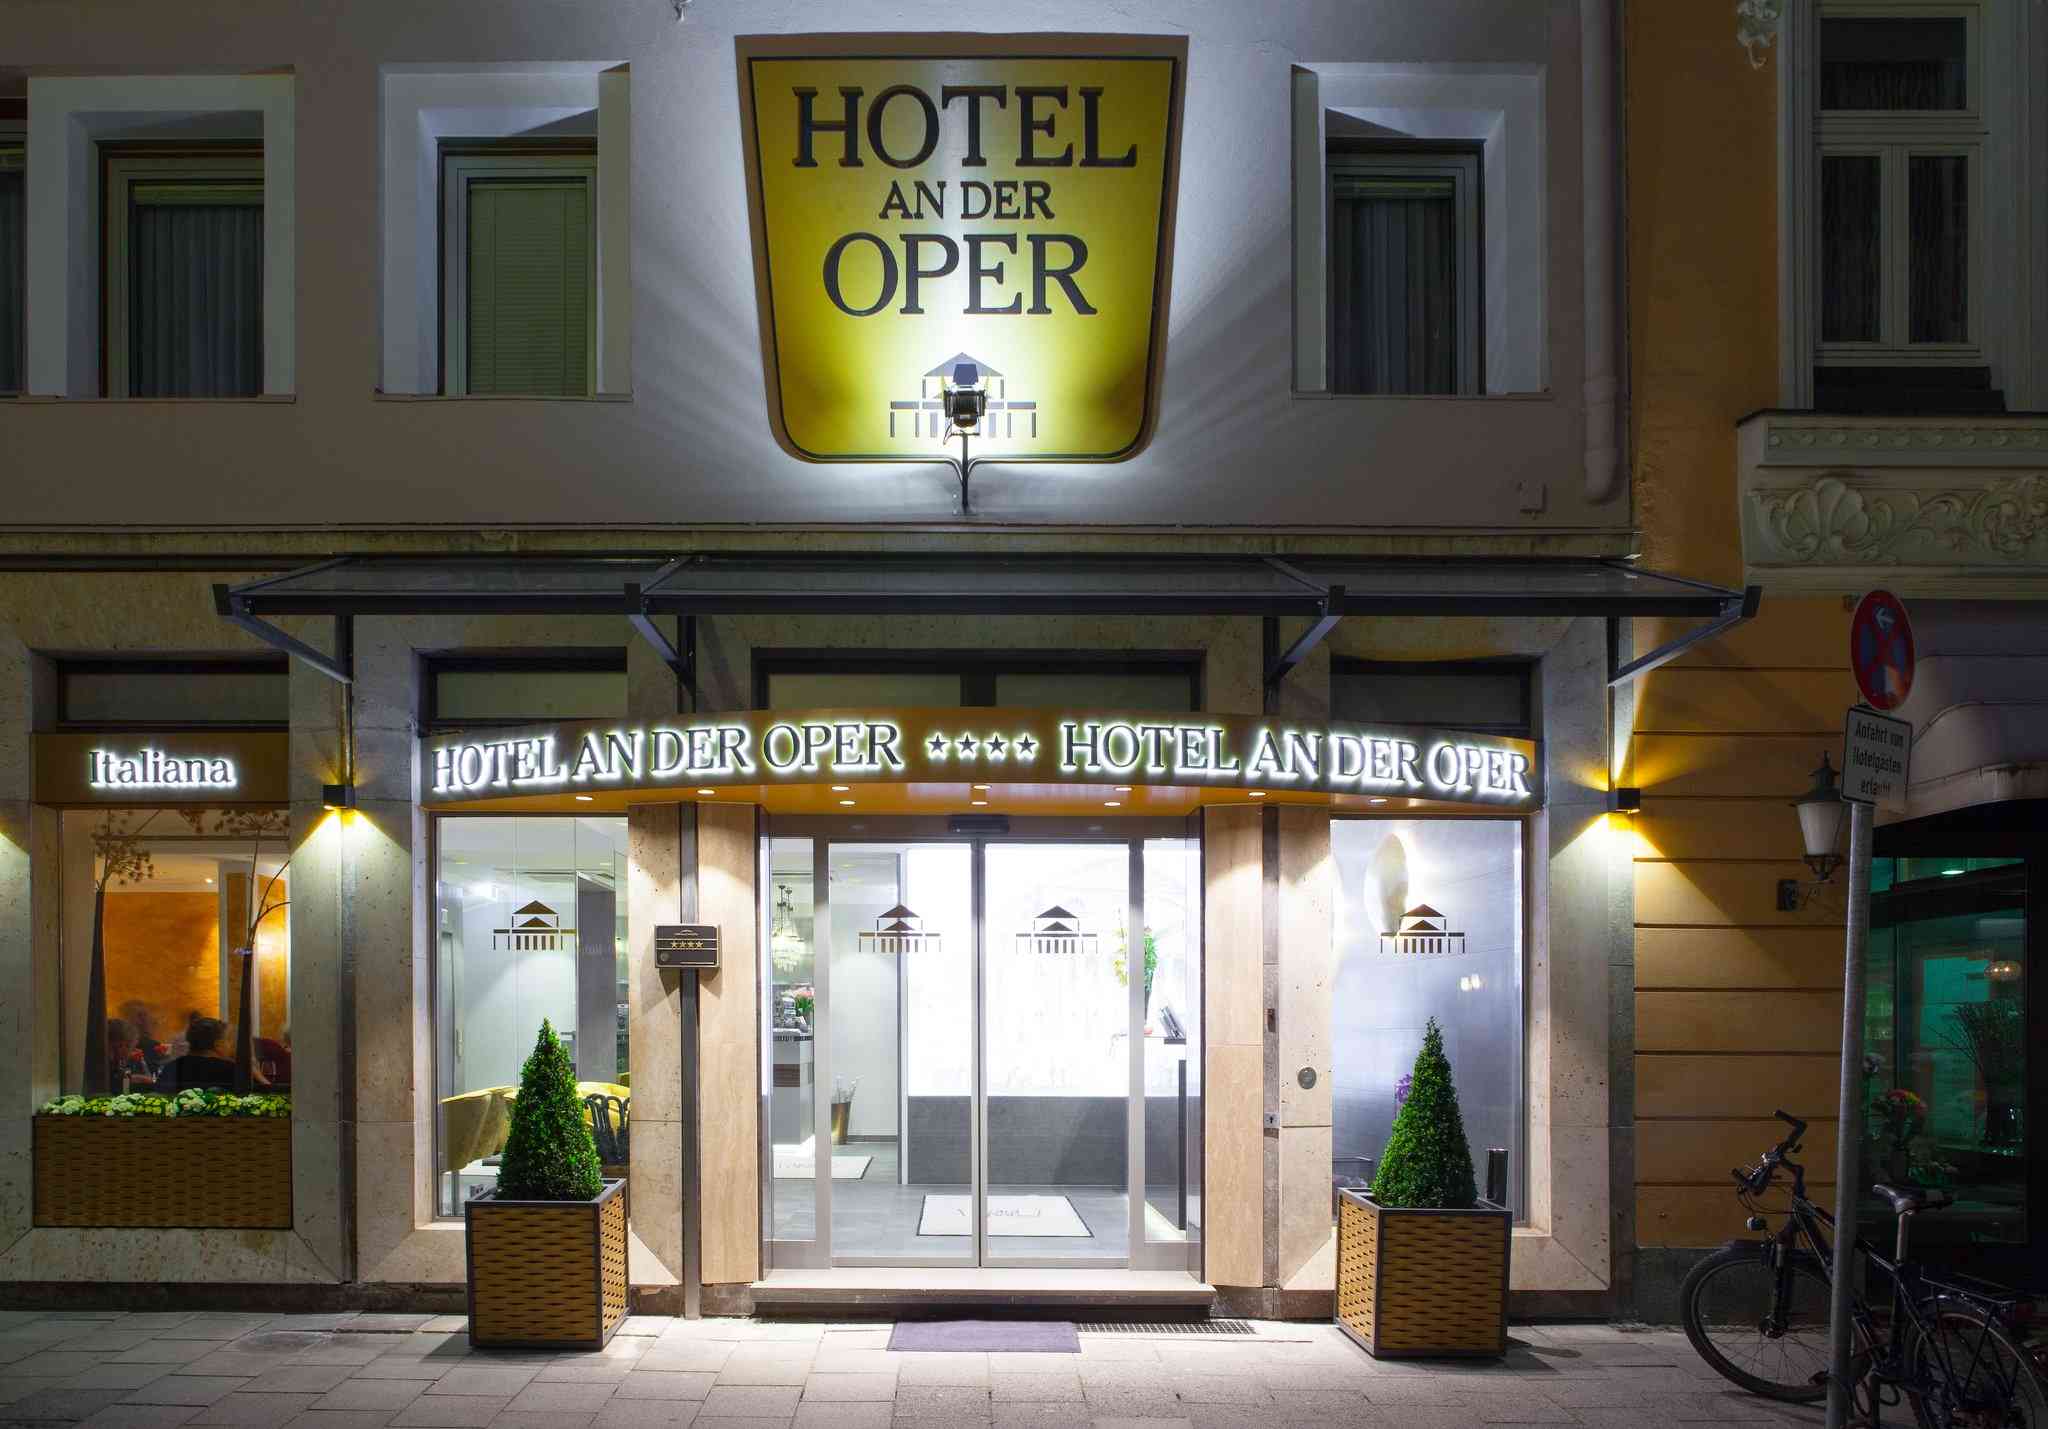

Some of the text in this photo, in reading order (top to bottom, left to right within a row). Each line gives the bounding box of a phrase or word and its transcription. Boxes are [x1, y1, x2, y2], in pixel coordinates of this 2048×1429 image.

[791, 84, 1138, 169] HOTEL
[878, 180, 1055, 220] AN DER
[822, 231, 1098, 317] OPER
[88, 750, 234, 785] Italiana
[431, 722, 902, 791] HOTEL AN DER OPER
[1062, 723, 1530, 796] HOTEL AN DER OPER
[1860, 777, 1890, 796] erla
